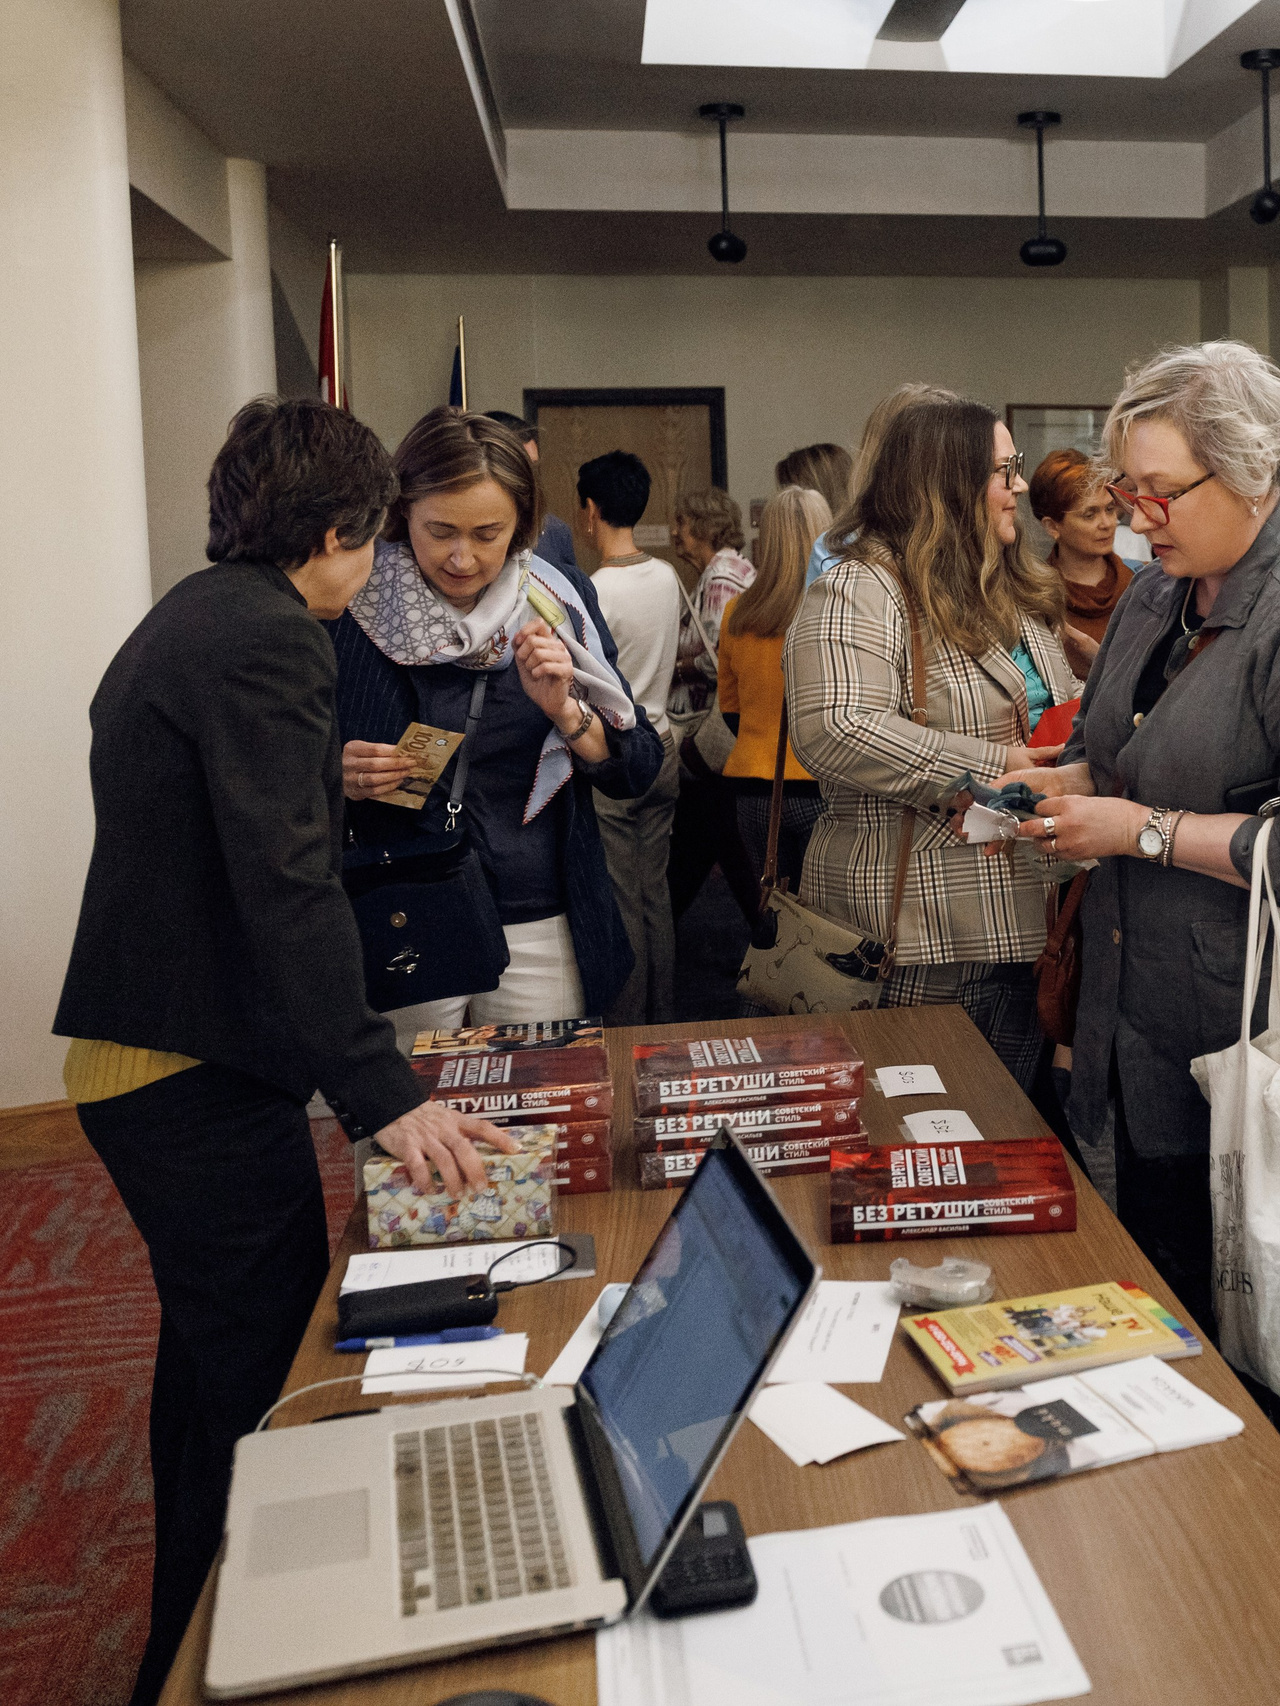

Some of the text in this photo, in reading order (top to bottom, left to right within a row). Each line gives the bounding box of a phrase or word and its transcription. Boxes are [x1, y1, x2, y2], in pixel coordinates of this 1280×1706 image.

[409, 730, 434, 751] 100
[659, 1067, 826, 1097] БЕЗ РЕТУШИ СОВЕТСКИЙ
[778, 1077, 806, 1086] СТИЛЬ
[521, 1088, 571, 1100] СОВЕТСКИЙ
[521, 1099, 550, 1108] СТИЛЬ
[655, 1103, 822, 1134] БЕЗ РЕТУШИ СОВЕТСКИЙ
[774, 1113, 802, 1123] СТИЛЬ
[737, 1132, 763, 1140] АСИЛЬЕВ
[664, 1139, 830, 1171] БЕЗ СОВЕТСКИЙ
[784, 1149, 810, 1158] СТИЛЬ
[912, 1147, 932, 1187] СОВЕТСКИЙ
[942, 1163, 959, 1186] СТИЛЬ
[853, 1195, 1034, 1223] БЕЗ РЕТУШИ СОВЕТСКИЙ
[983, 1206, 1012, 1216] СТИЛЬ
